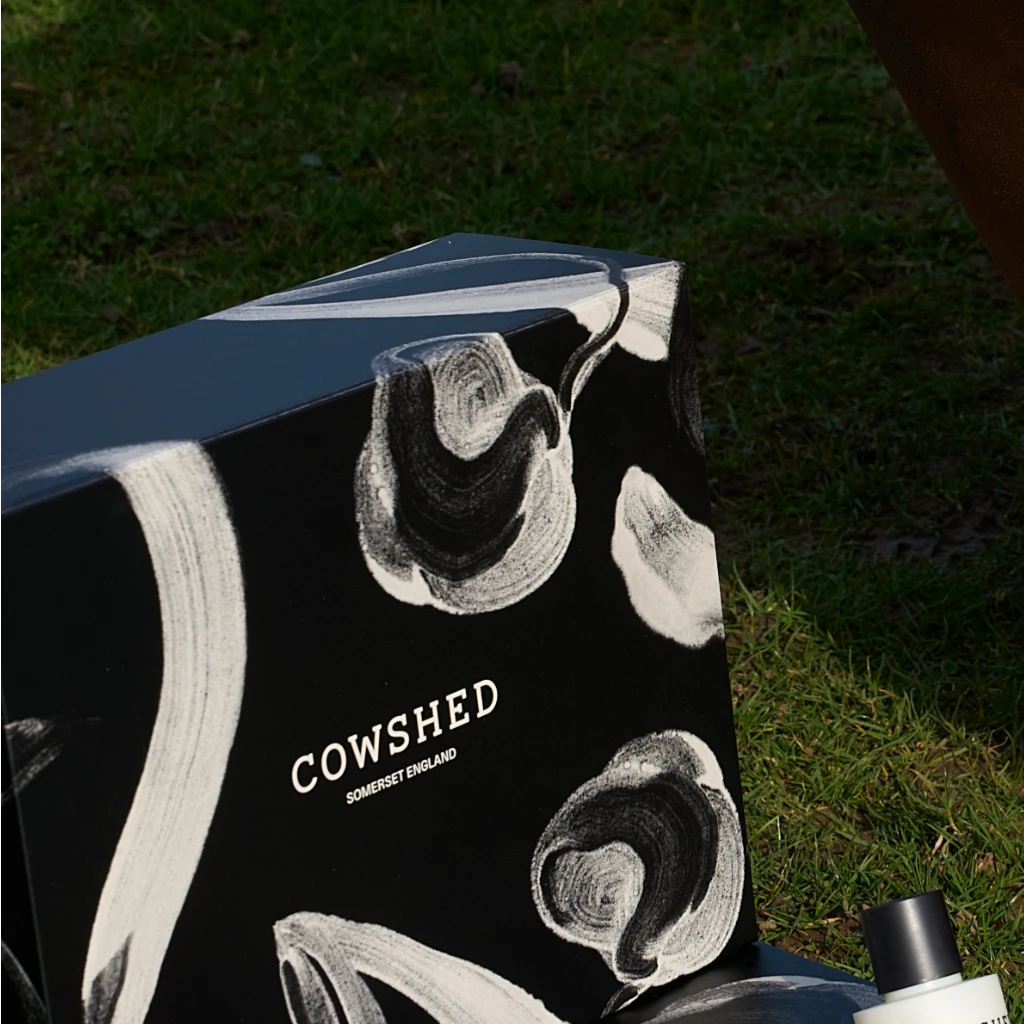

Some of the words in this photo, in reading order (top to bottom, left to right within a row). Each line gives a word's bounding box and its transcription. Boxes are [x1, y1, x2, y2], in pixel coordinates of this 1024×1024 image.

[291, 679, 499, 794] COWSHED
[346, 769, 404, 805] SOMERSET
[406, 747, 457, 779] ENGLAND
